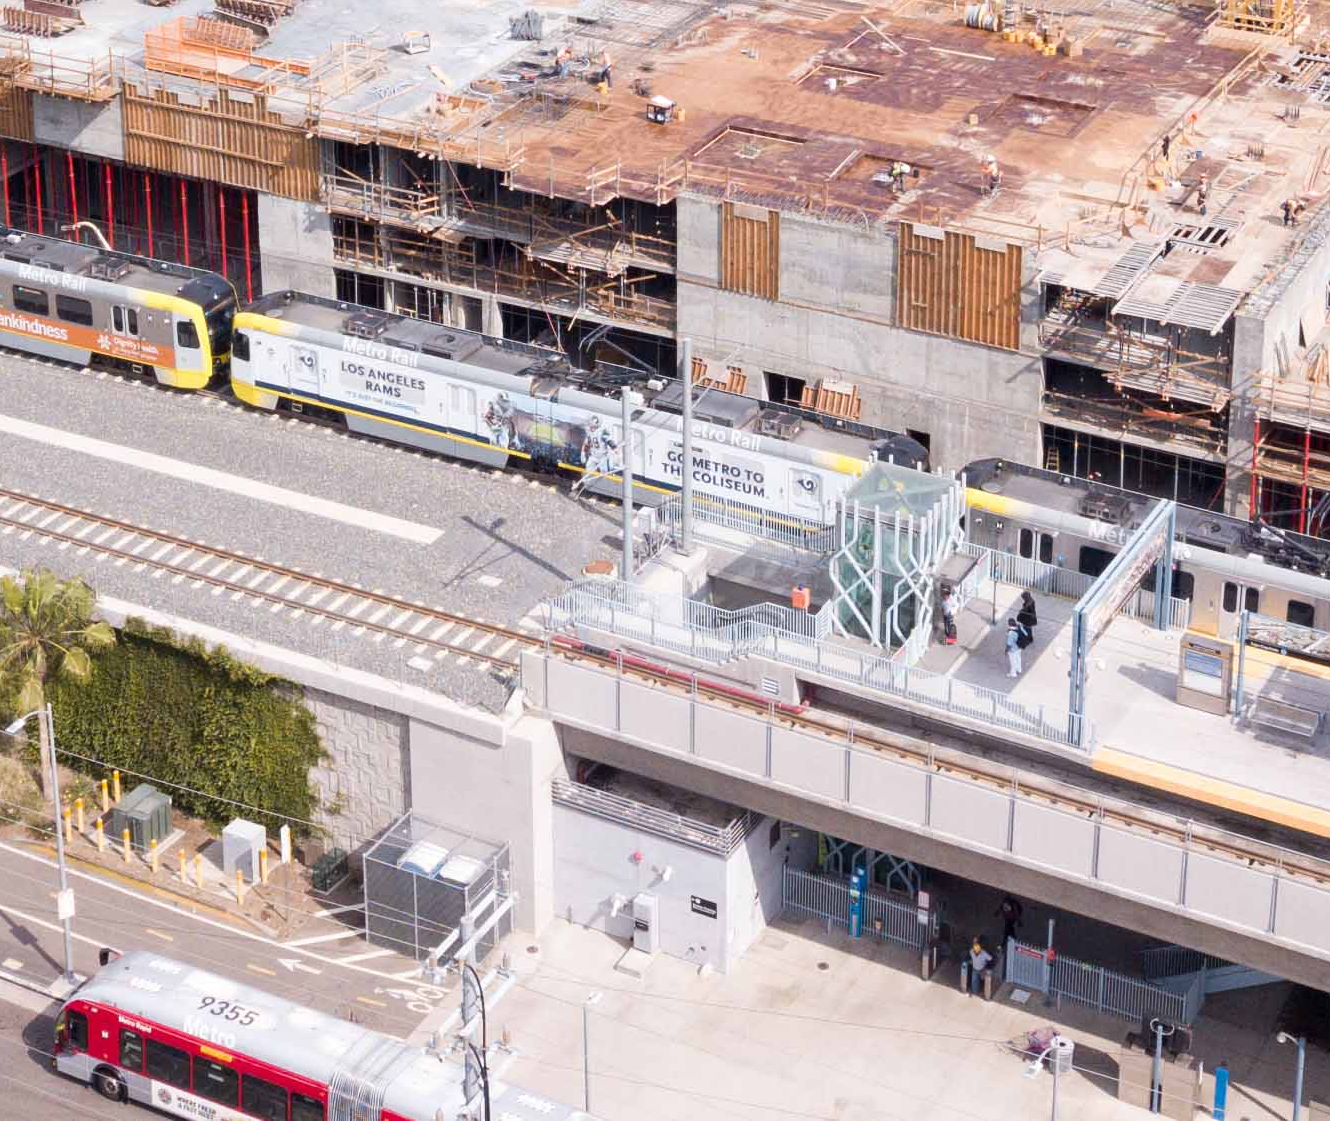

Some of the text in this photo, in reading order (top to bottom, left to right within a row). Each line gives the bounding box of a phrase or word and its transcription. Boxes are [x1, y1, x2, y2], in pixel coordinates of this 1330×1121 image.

[19, 265, 86, 292] Metro Rail
[343, 336, 418, 367] Metro Rail
[341, 361, 425, 391] LOS ANGELES
[366, 381, 401, 398] RAMS
[731, 430, 761, 452] Rail
[693, 457, 740, 476] METRO
[745, 470, 764, 484] TO
[693, 470, 765, 497] COLISEUM
[197, 996, 260, 1026] 9355
[183, 1015, 237, 1048] Metro
